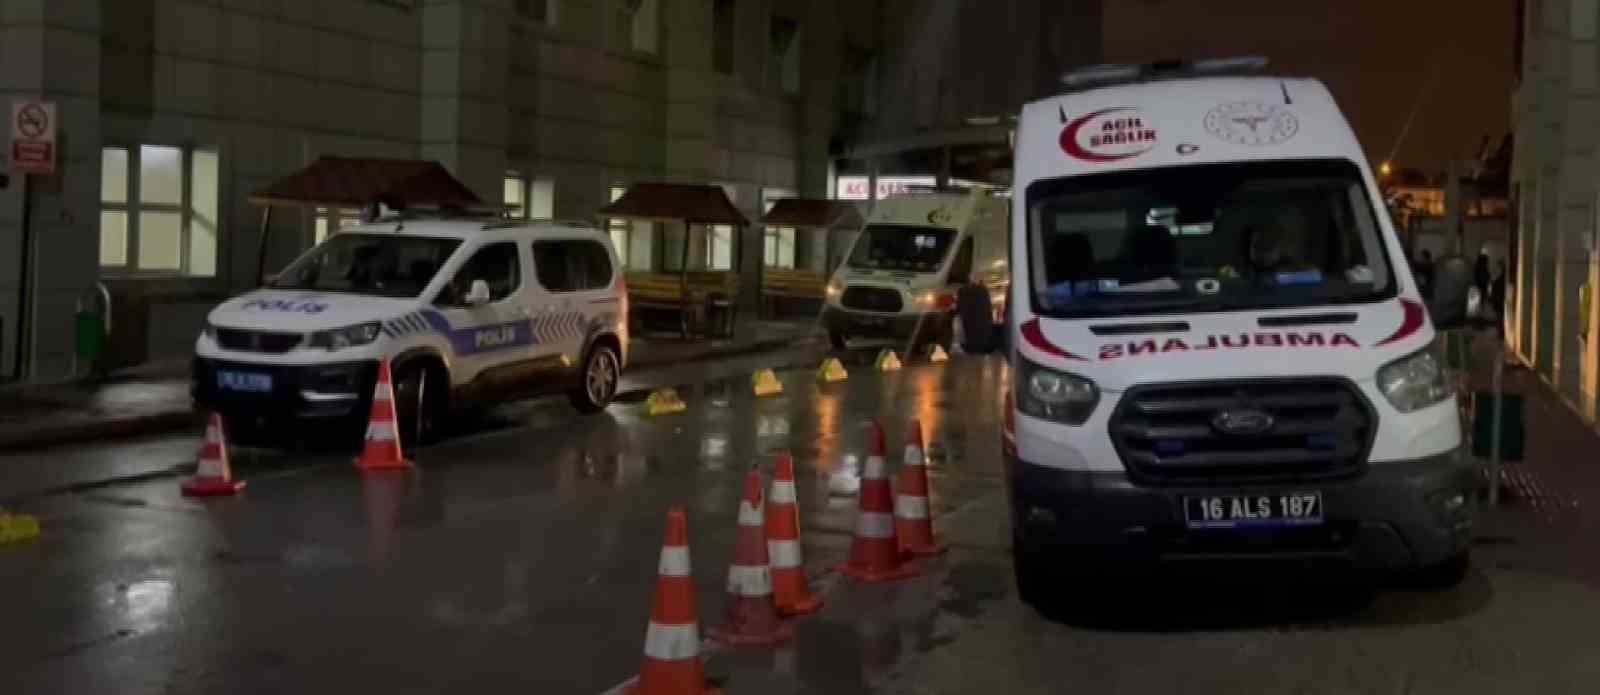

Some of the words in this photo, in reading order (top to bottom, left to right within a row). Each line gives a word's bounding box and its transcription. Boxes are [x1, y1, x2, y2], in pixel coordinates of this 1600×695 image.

[1200, 496, 1225, 520] 16
[1230, 496, 1272, 519] ALS
[1279, 495, 1317, 518] 187
